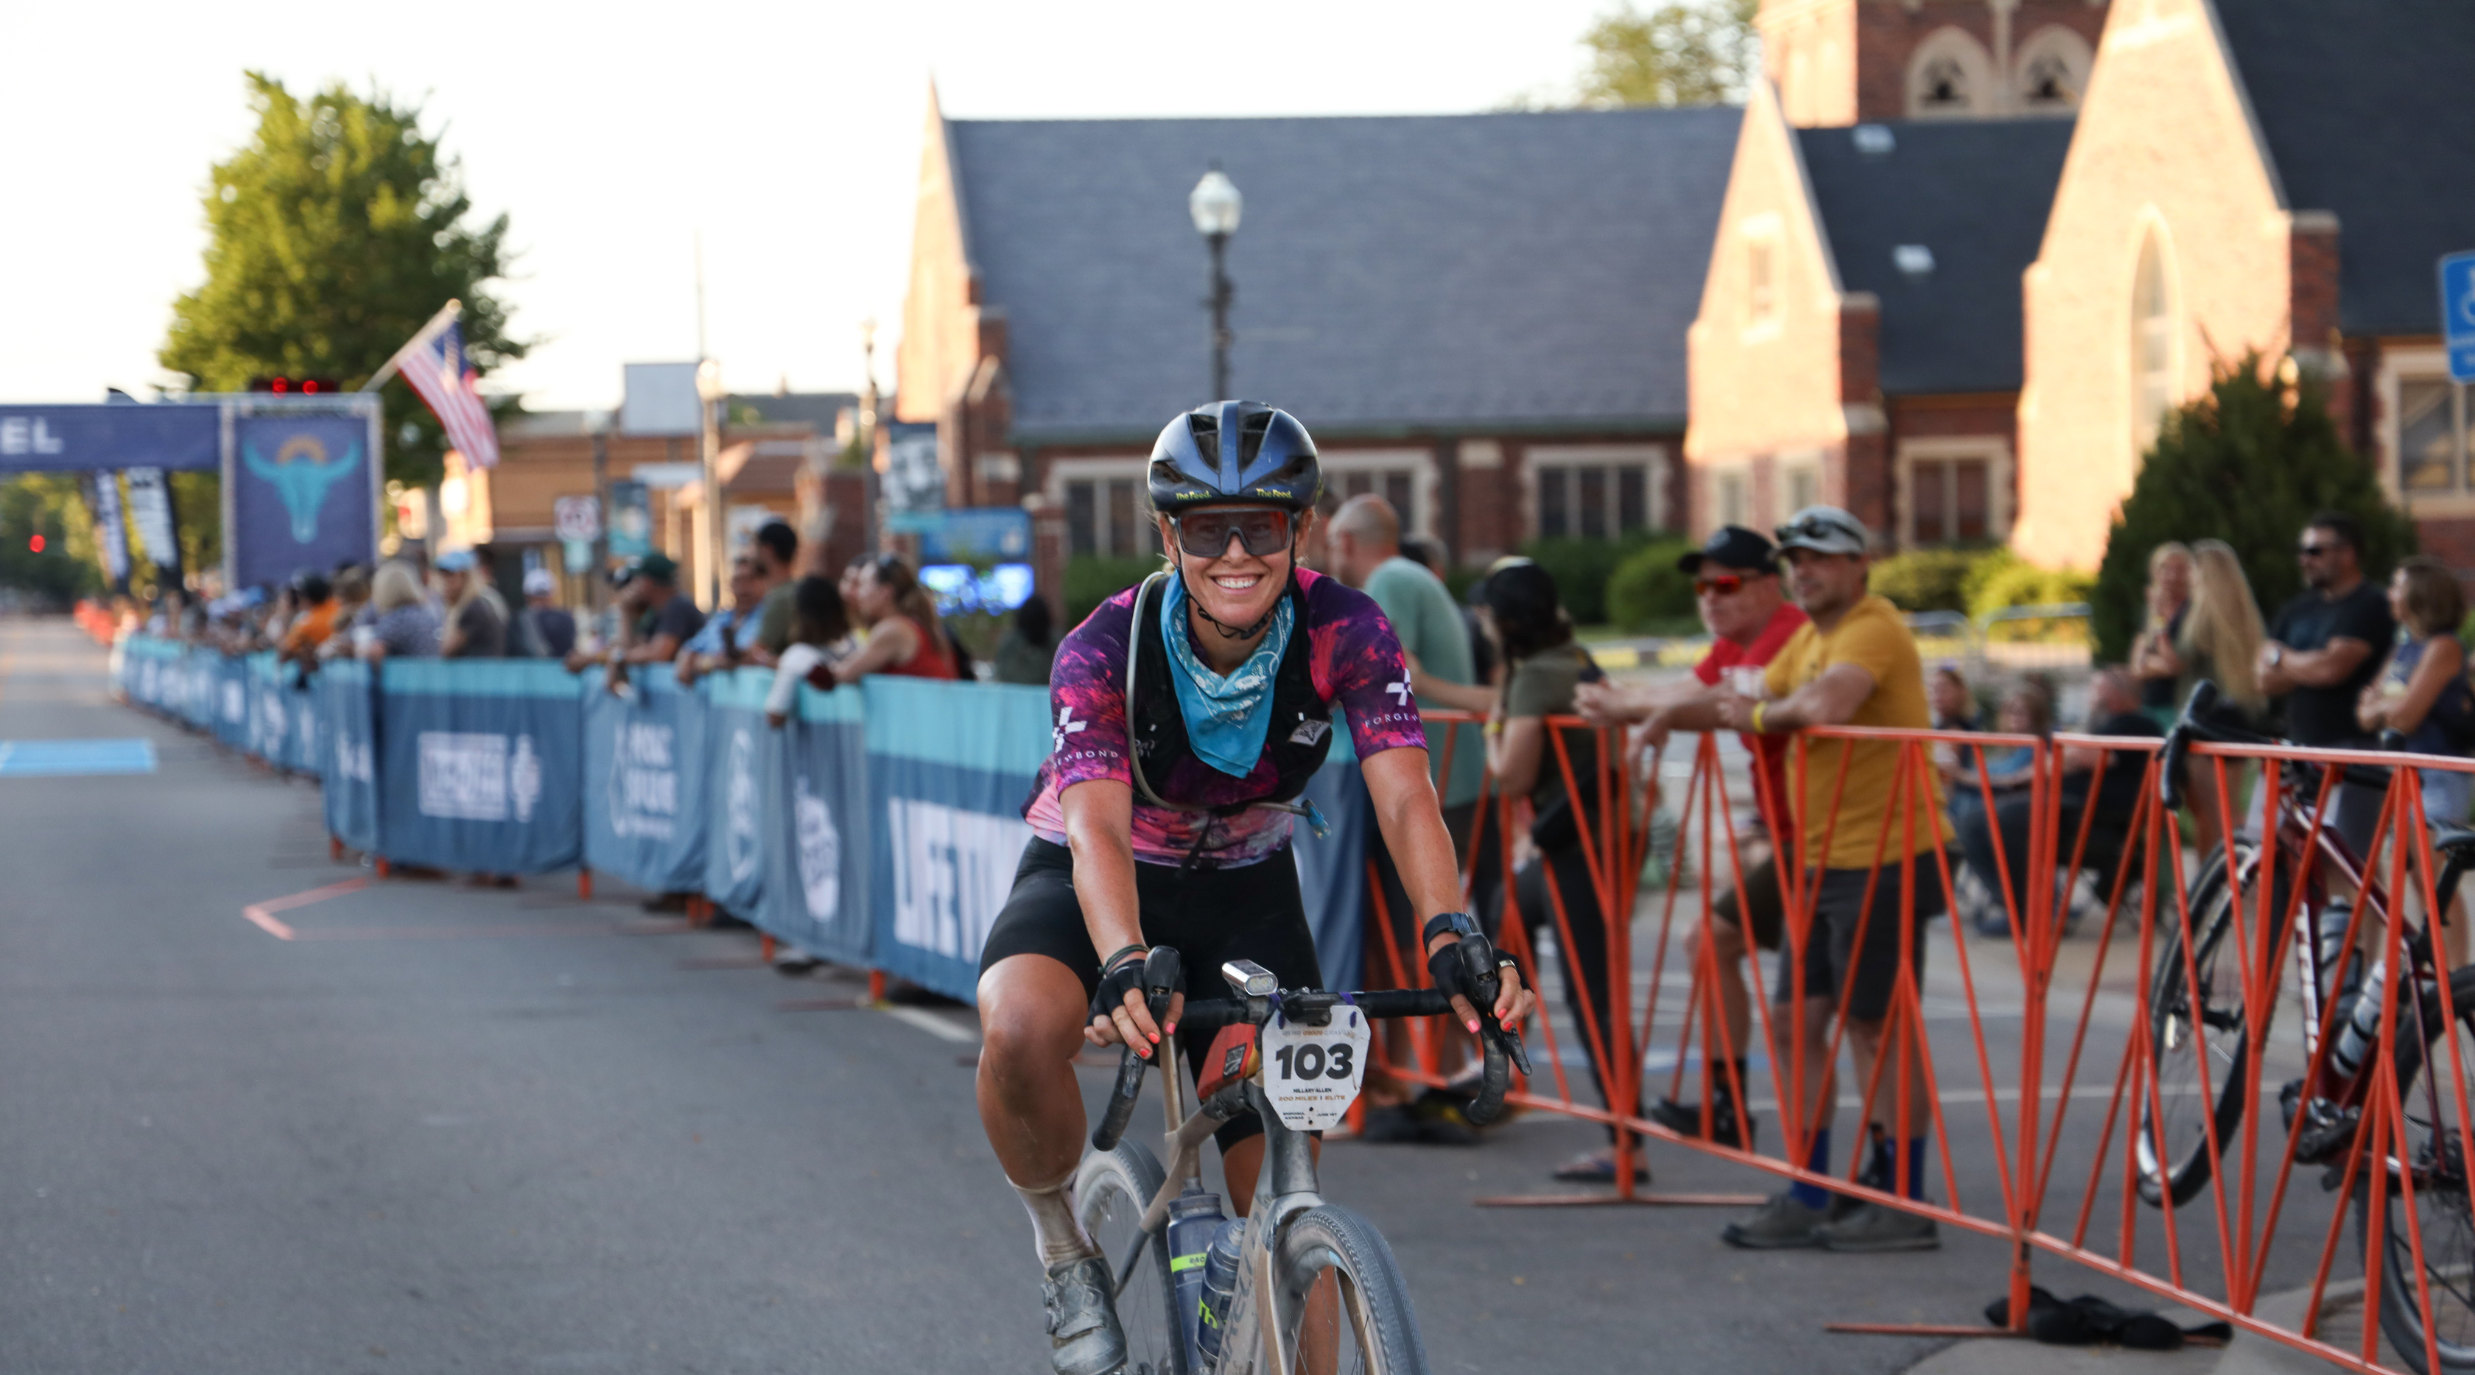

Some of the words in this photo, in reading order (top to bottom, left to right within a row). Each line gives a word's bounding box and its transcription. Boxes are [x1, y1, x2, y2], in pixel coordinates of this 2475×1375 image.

[1175, 492, 1189, 500] The
[1256, 487, 1272, 498] The
[1275, 1043, 1354, 1080] 103
